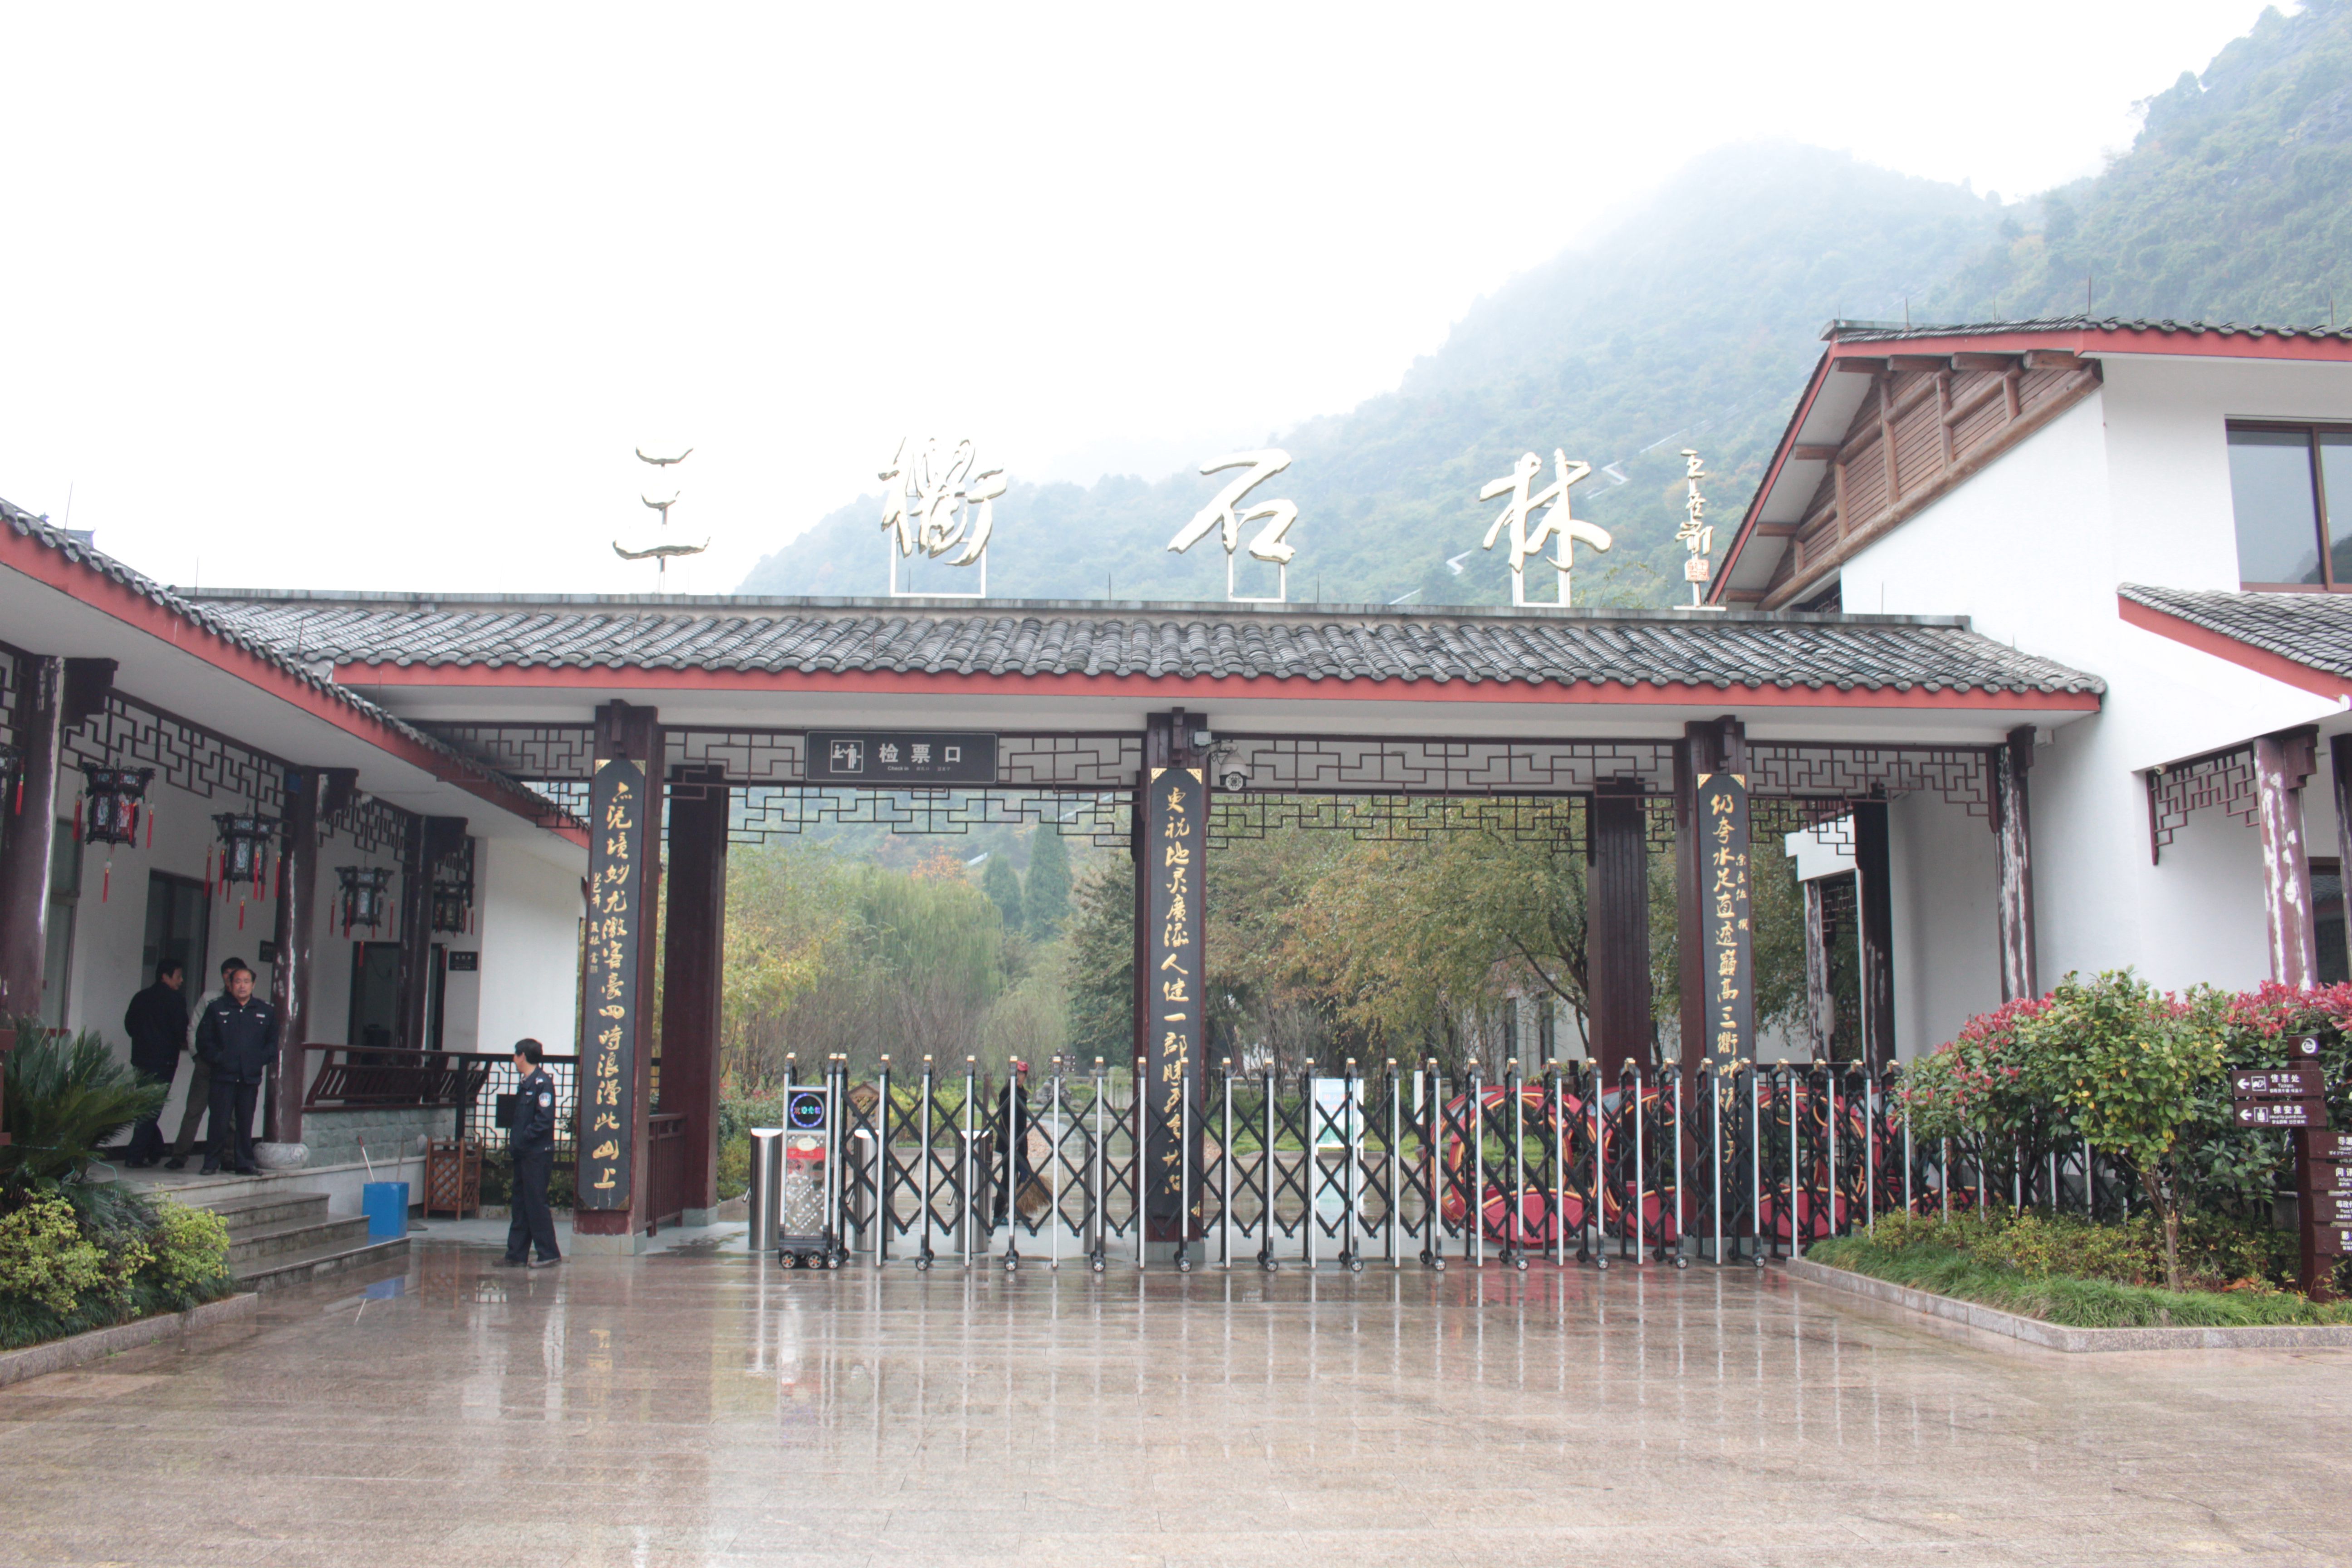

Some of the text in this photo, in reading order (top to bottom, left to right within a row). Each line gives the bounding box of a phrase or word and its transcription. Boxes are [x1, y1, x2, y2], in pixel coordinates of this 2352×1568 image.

[879, 743, 960, 764] 检票口
[2270, 1074, 2300, 1083] 售票处
[2273, 1105, 2302, 1114] 保安室
[2341, 1231, 2352, 1240] 影
